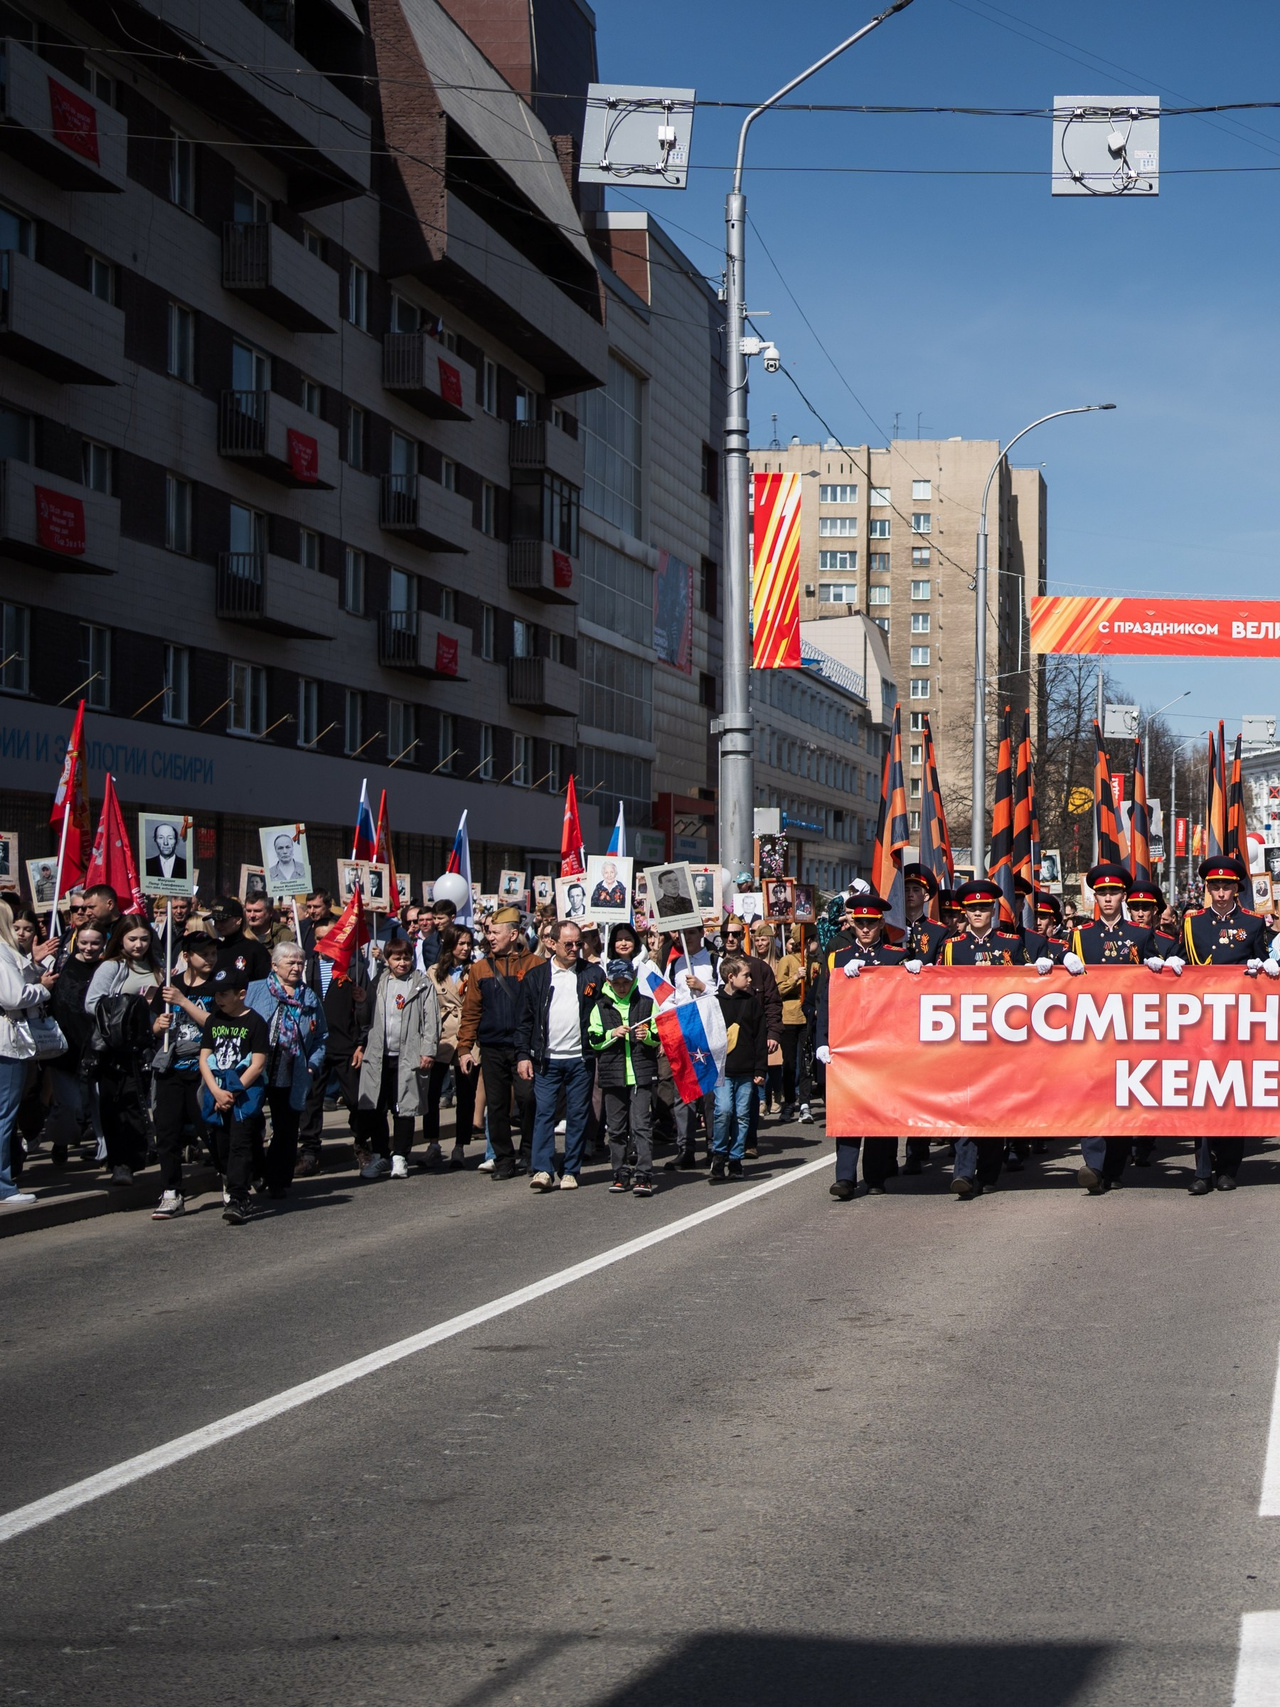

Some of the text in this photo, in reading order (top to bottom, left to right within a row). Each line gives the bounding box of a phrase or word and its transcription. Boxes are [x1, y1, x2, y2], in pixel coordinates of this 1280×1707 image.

[1098, 621, 1110, 633] С
[1114, 621, 1218, 636] ПРАЗДНИКОМ
[0, 727, 30, 760] ИИ
[35, 732, 49, 762] И
[151, 750, 214, 785] СИБИРИ
[211, 1025, 249, 1039] BORN TO BE
